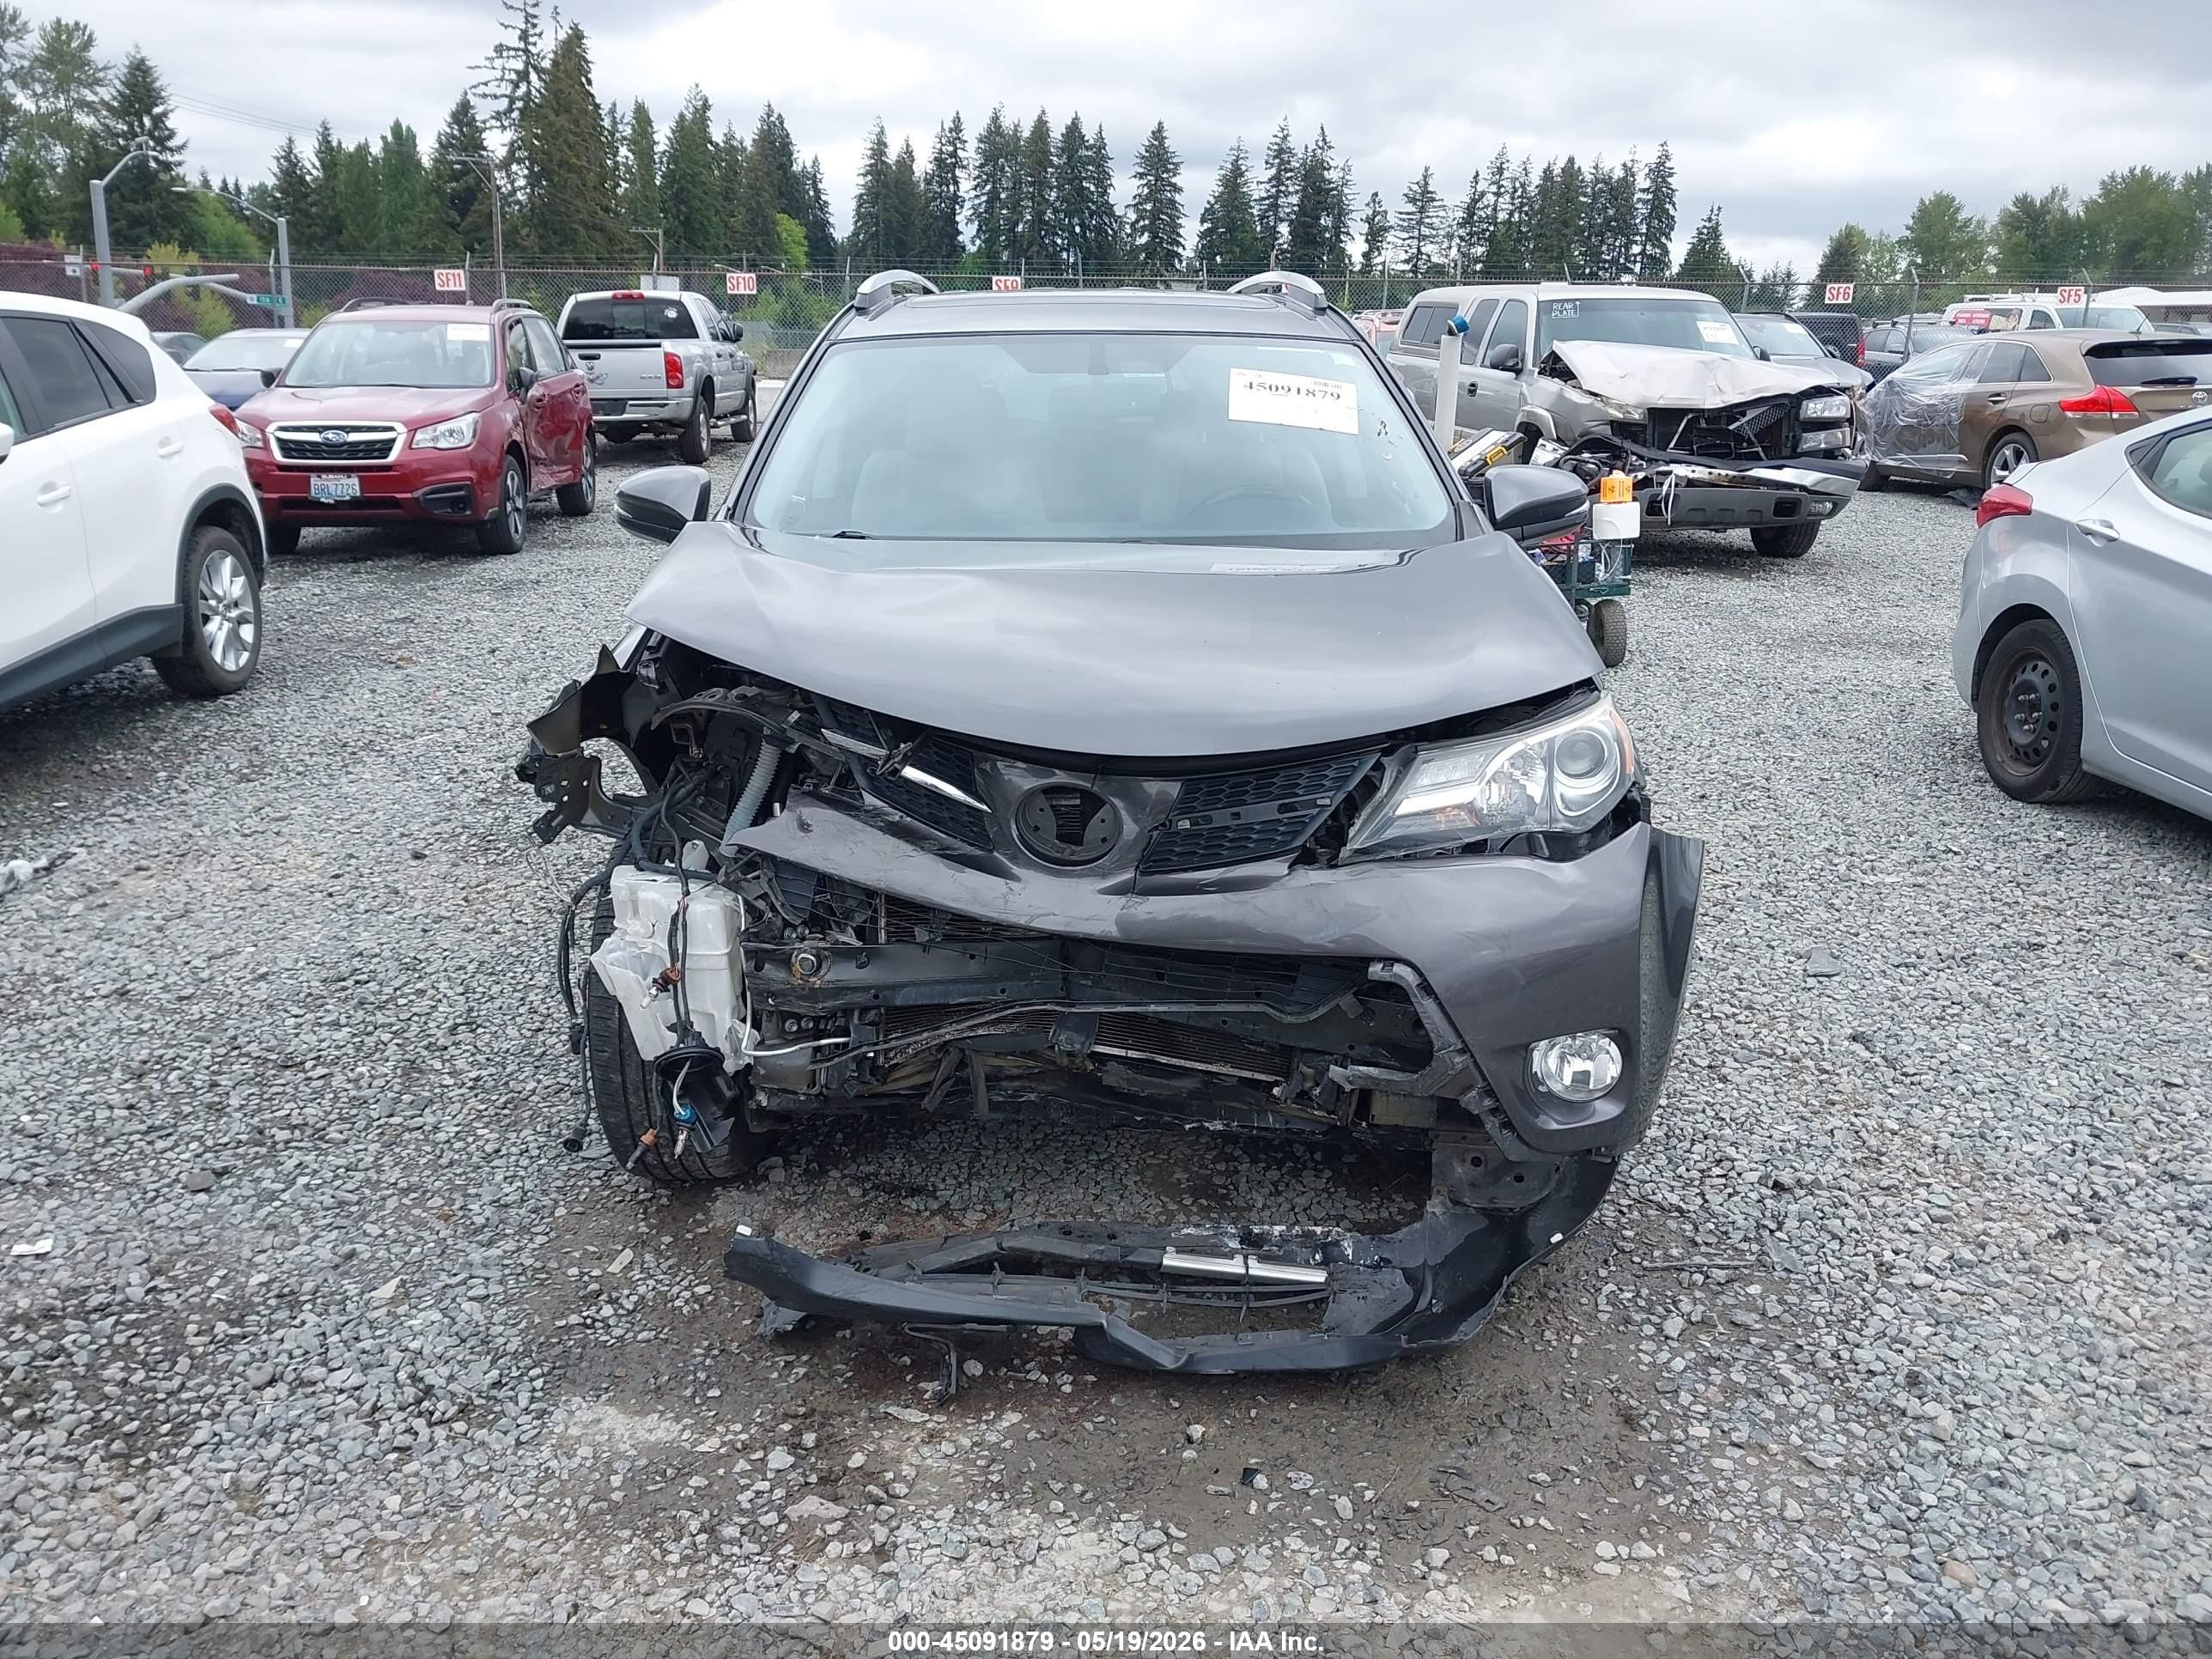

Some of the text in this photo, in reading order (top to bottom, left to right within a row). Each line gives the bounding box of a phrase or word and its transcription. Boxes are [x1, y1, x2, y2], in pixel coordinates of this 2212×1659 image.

[437, 271, 462, 288] SF11
[727, 275, 755, 292] SF10
[1826, 286, 1851, 301] SF6
[2058, 288, 2082, 304] SF5
[1553, 301, 1574, 311] REAR
[1243, 380, 1341, 401] 45091879
